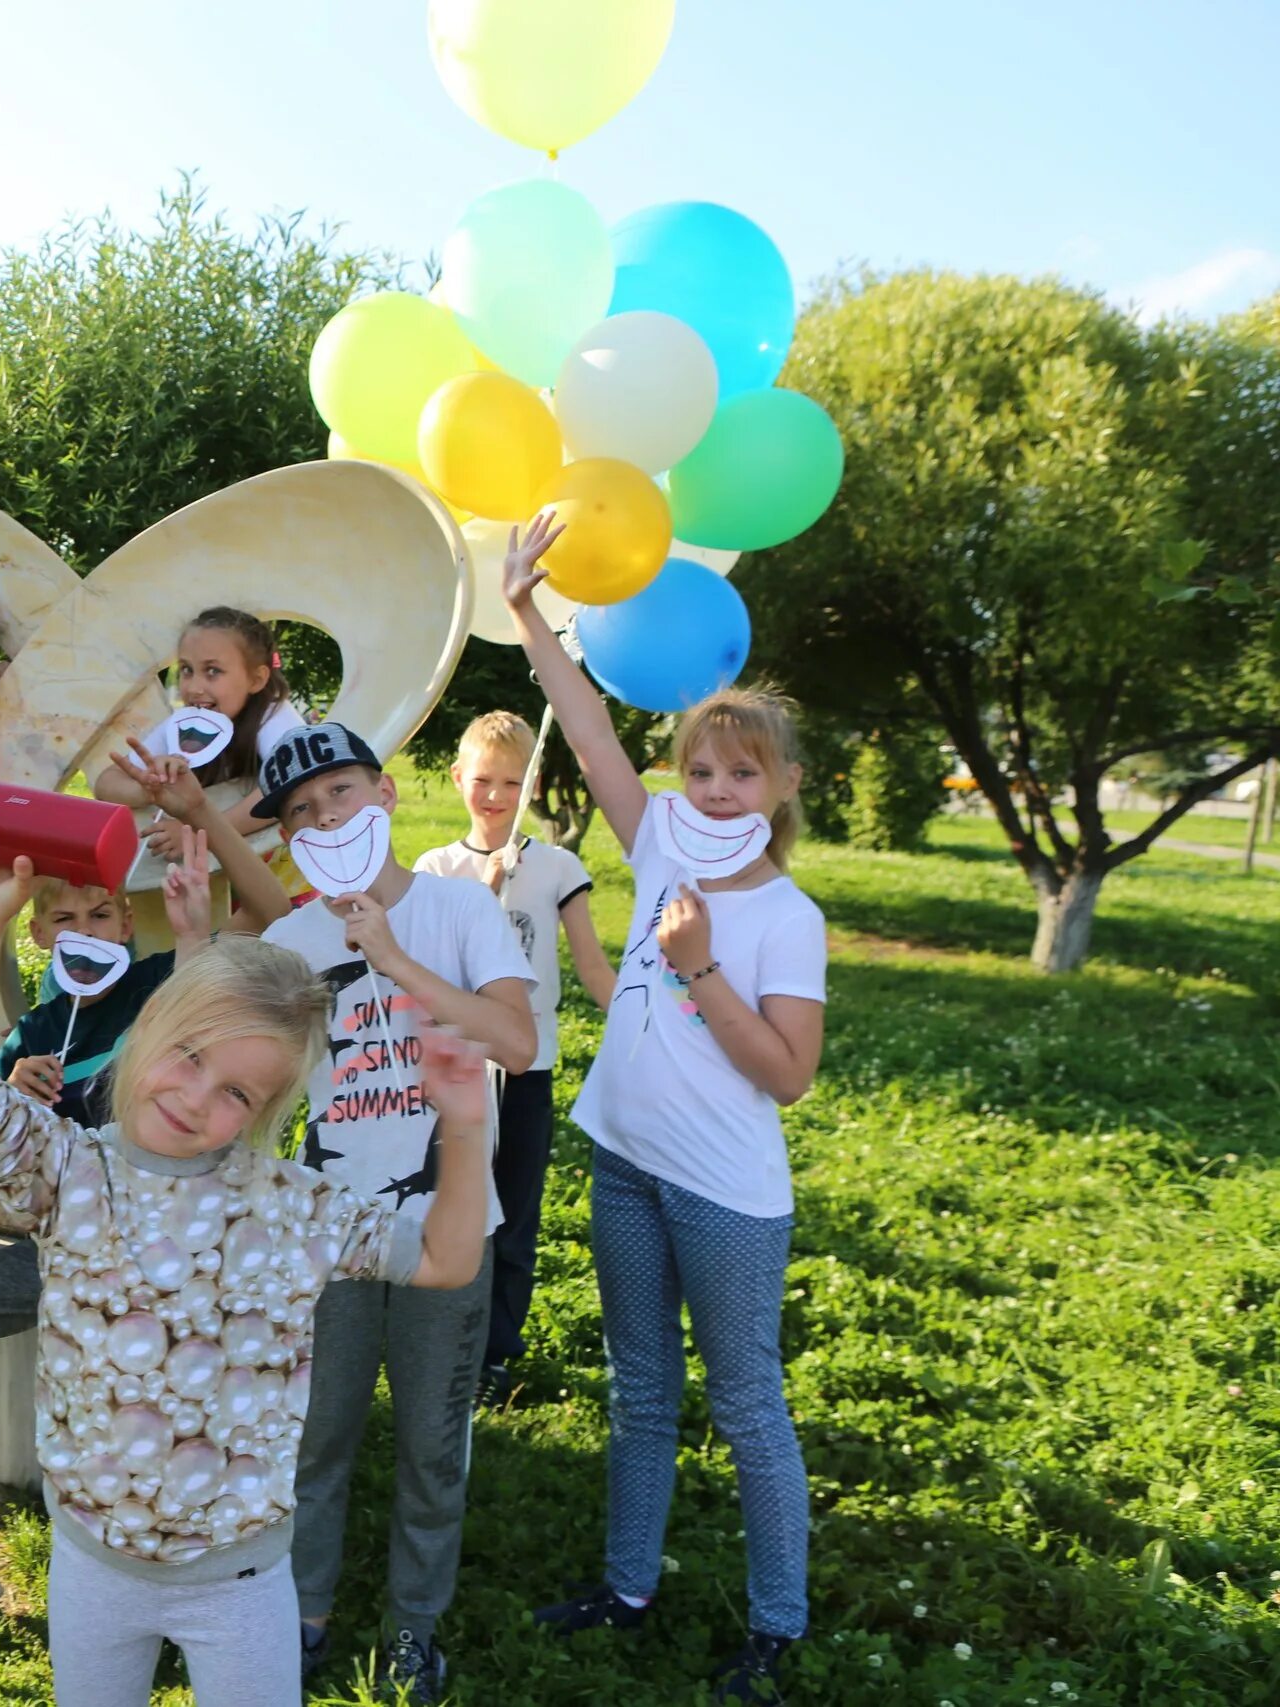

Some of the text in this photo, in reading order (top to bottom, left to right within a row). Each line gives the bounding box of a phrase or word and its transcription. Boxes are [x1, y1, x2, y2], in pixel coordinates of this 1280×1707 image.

[264, 733, 335, 792] EPIC
[354, 995, 392, 1032] SUN
[363, 1036, 424, 1072] SAND
